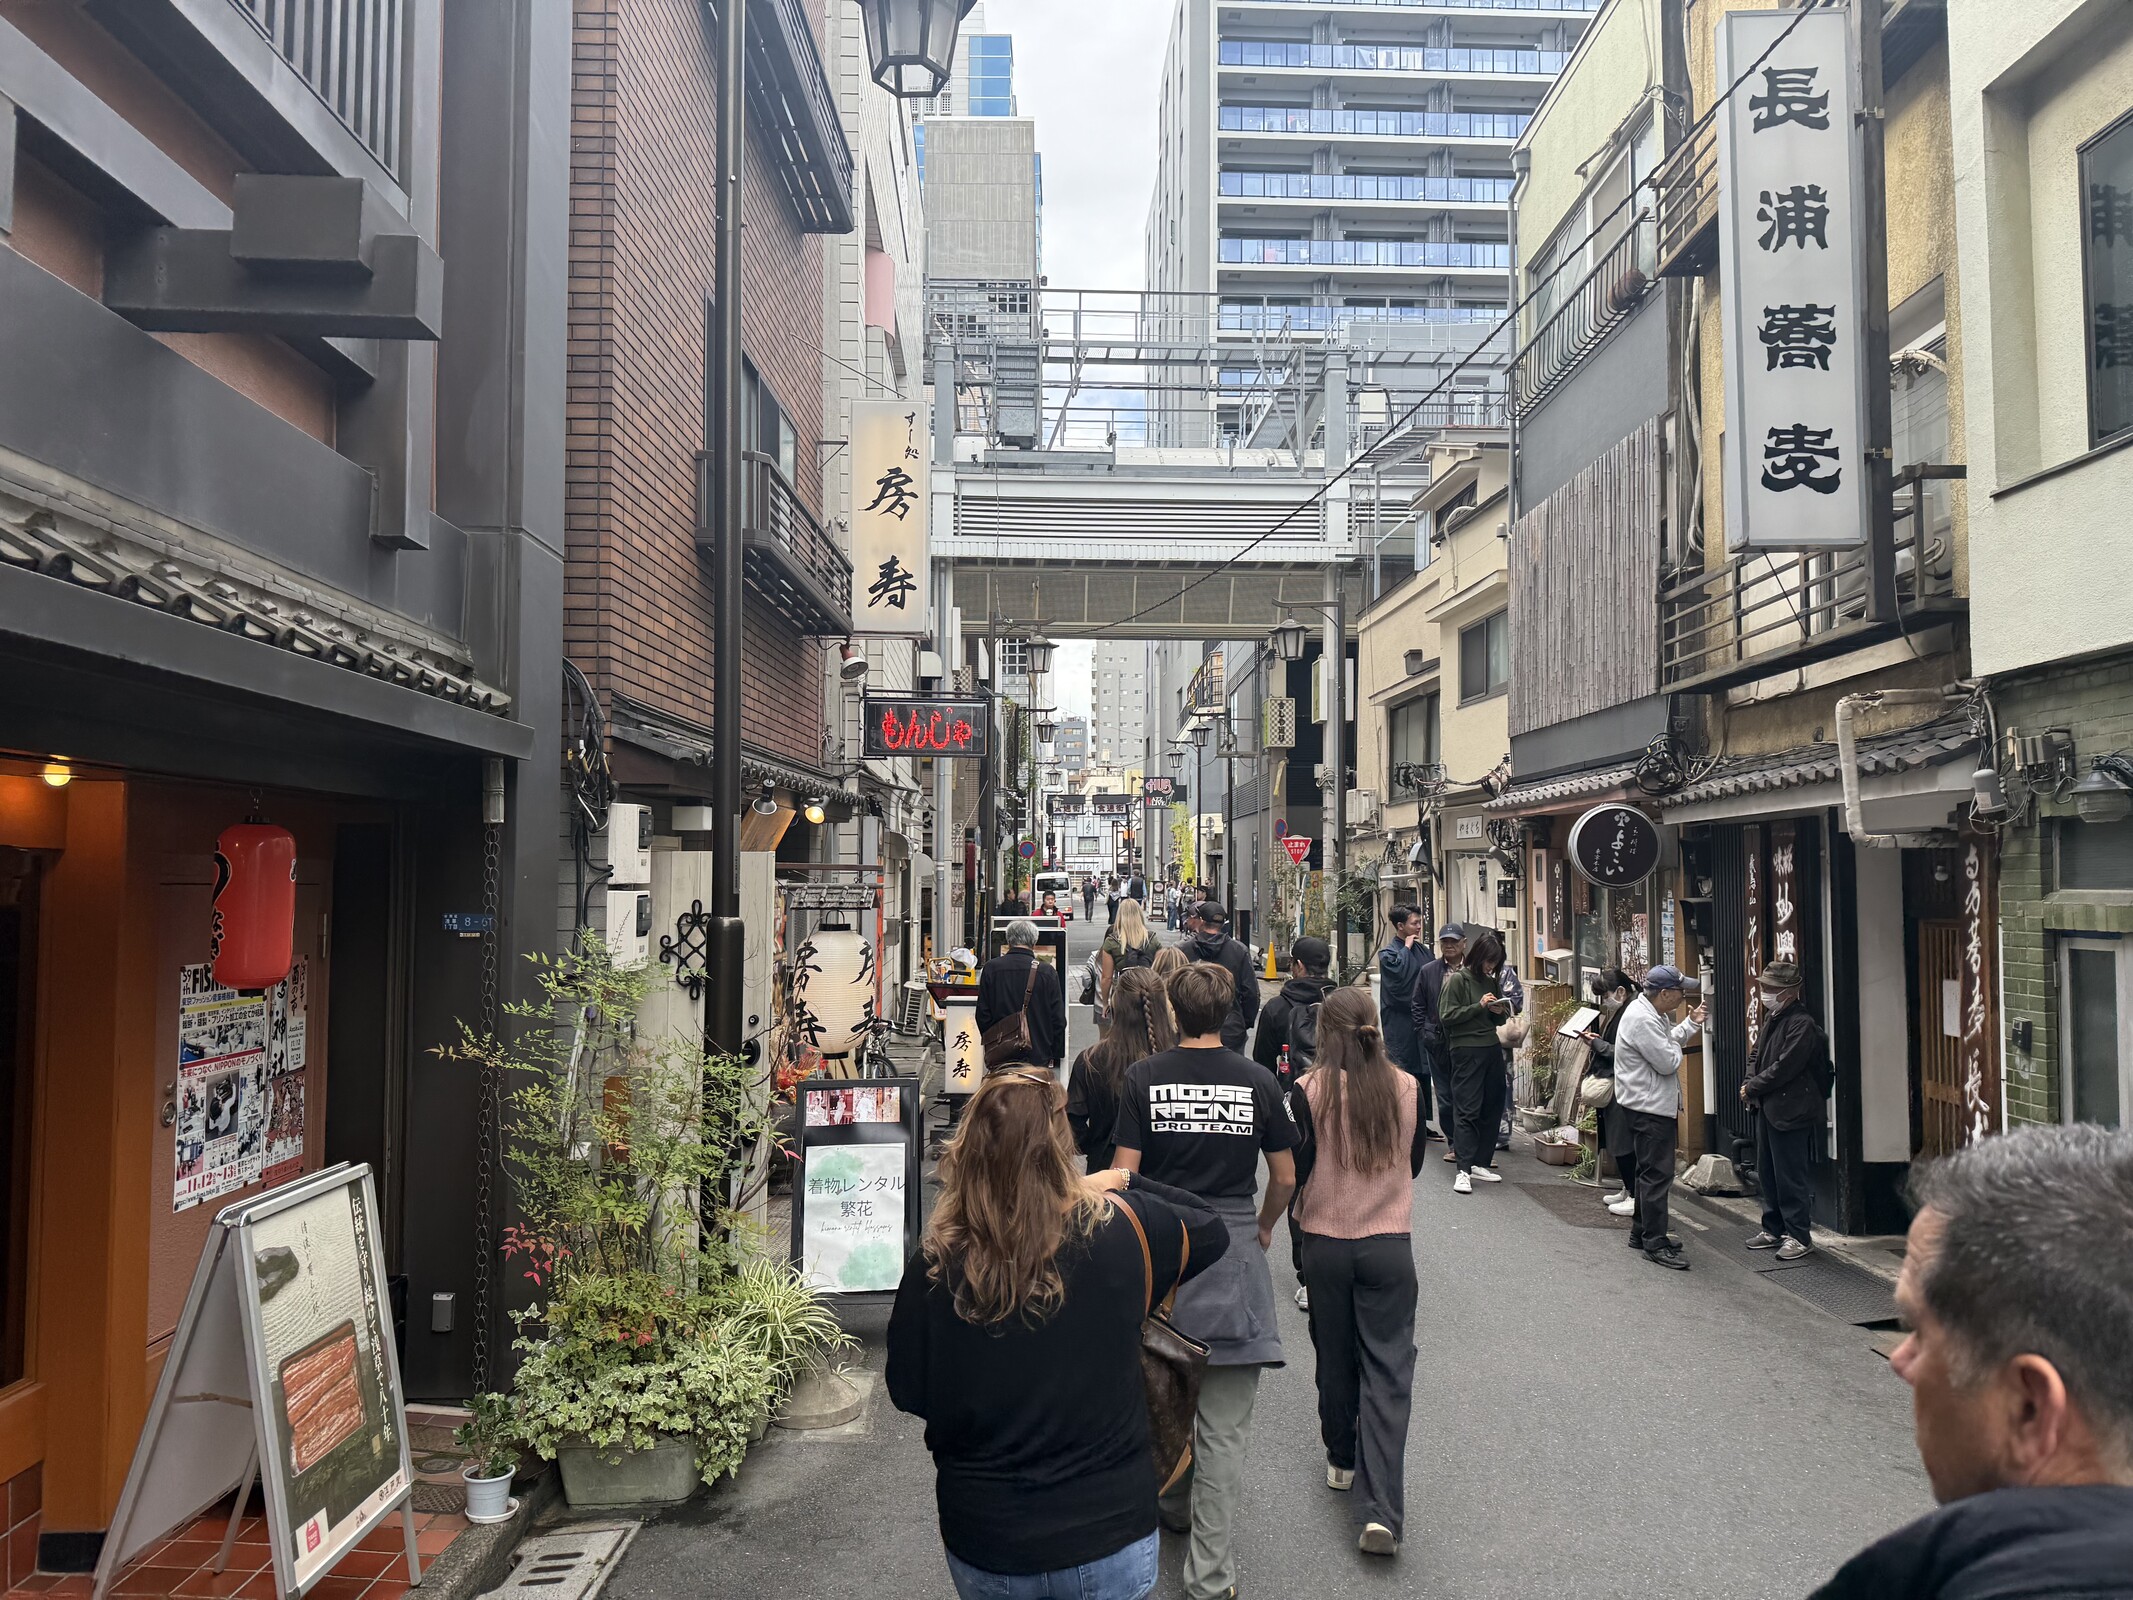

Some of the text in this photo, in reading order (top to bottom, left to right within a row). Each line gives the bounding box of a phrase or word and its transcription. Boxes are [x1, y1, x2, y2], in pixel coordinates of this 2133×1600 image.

[1748, 65, 1842, 495] 長浦蕎麦
[904, 411, 920, 460] すし処
[857, 466, 919, 610] 房寿
[882, 705, 972, 750] もんじゃ
[1145, 778, 1172, 794] HUB
[951, 1030, 972, 1079] 房寿
[1149, 1083, 1254, 1104] MOOSE
[1150, 1102, 1254, 1122] RACING
[1154, 1122, 1251, 1134] PRO TEAM
[808, 1175, 906, 1196] 着物レンタル
[840, 1200, 873, 1217] 繁花
